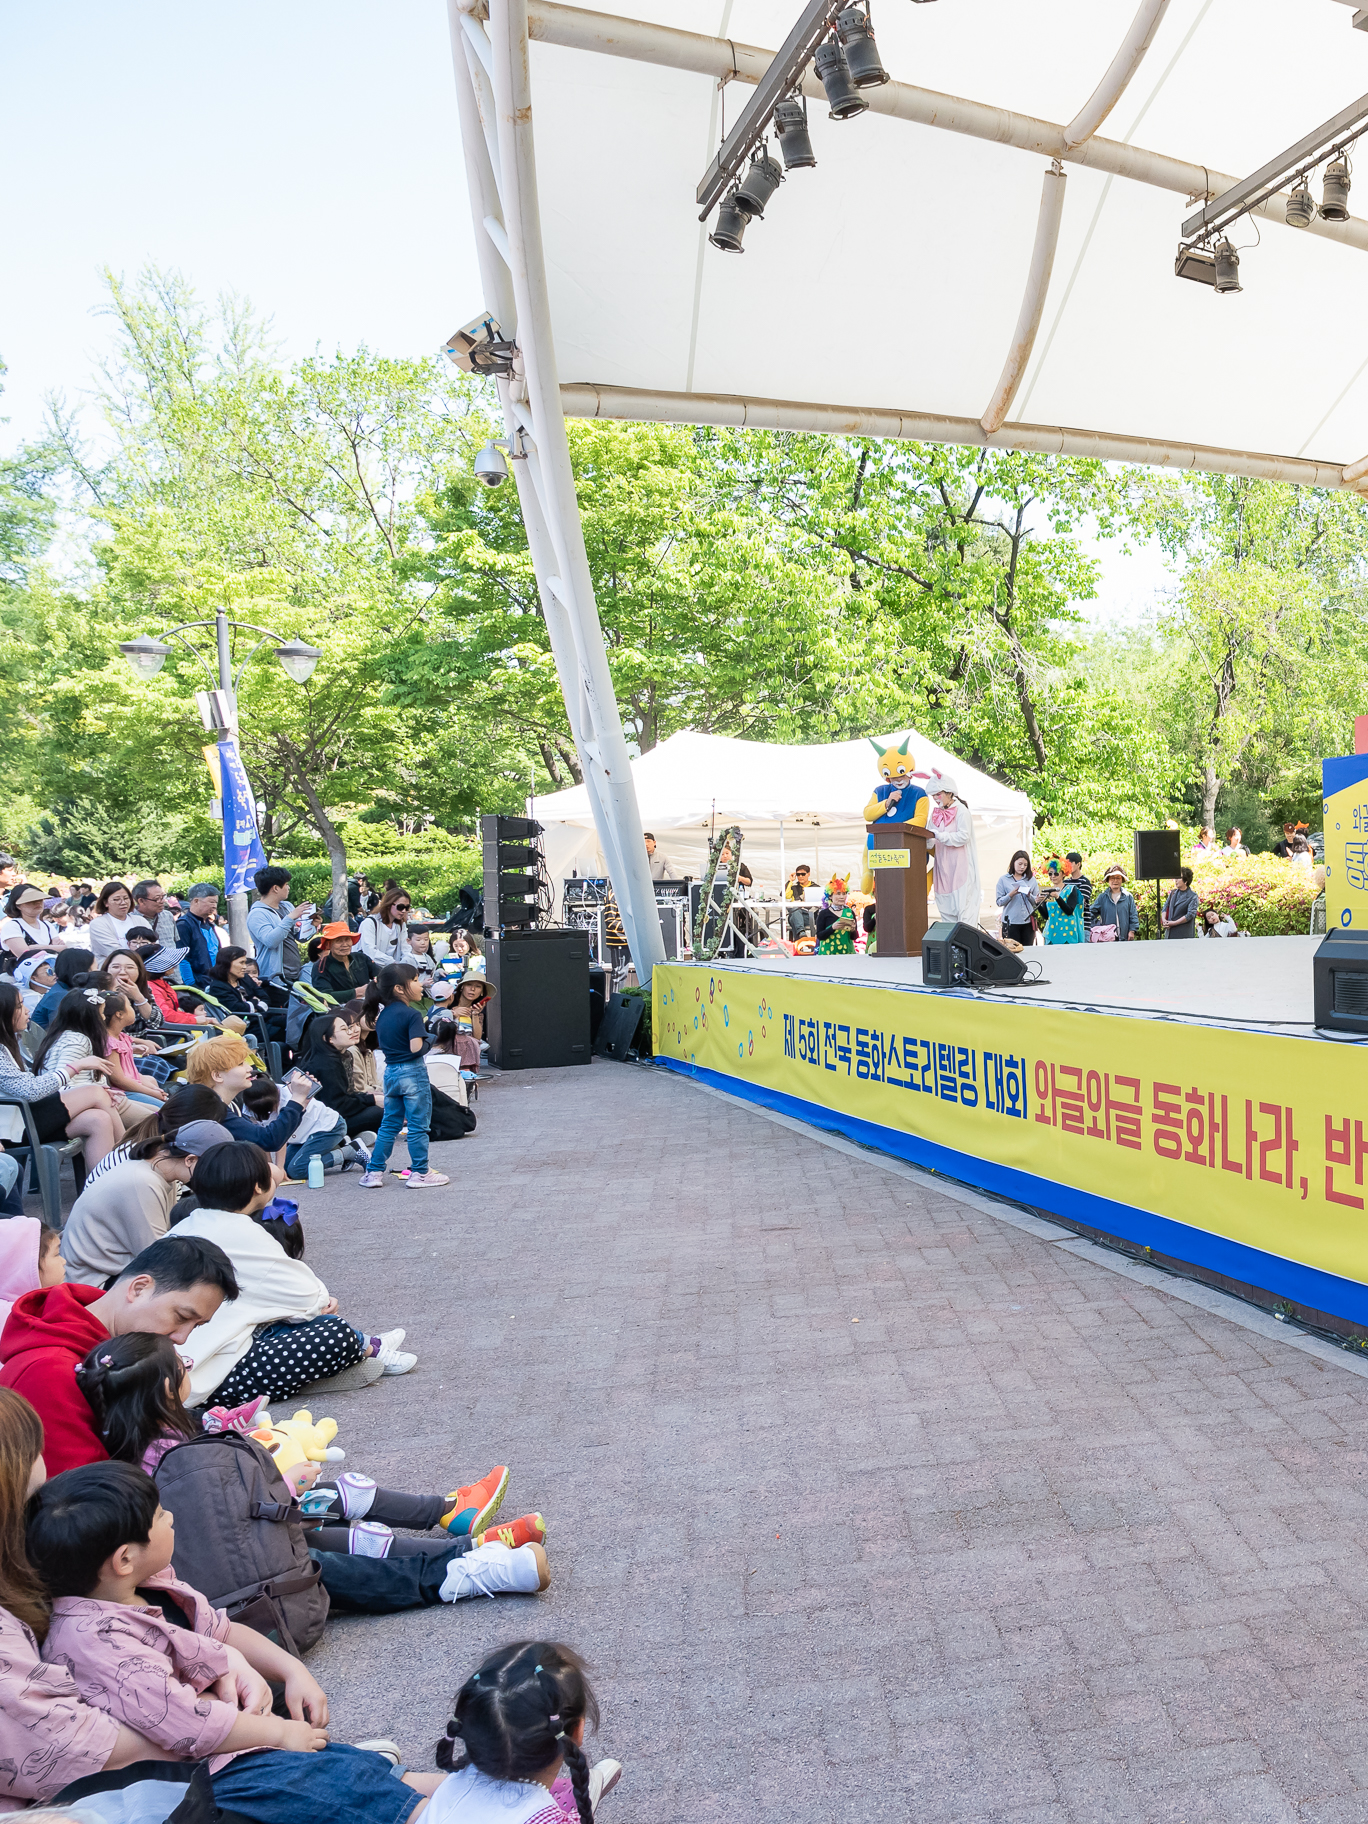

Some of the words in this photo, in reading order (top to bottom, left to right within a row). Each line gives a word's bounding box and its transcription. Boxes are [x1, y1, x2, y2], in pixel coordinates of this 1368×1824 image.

[783, 1013, 796, 1060] 제
[798, 1017, 821, 1067] 5회
[823, 1021, 853, 1077] 전국
[855, 1027, 979, 1108] 동화스토리텔링
[983, 1051, 1029, 1120] 대회
[1034, 1059, 1144, 1151] 와글와글
[1151, 1081, 1309, 1201] 동화나라,
